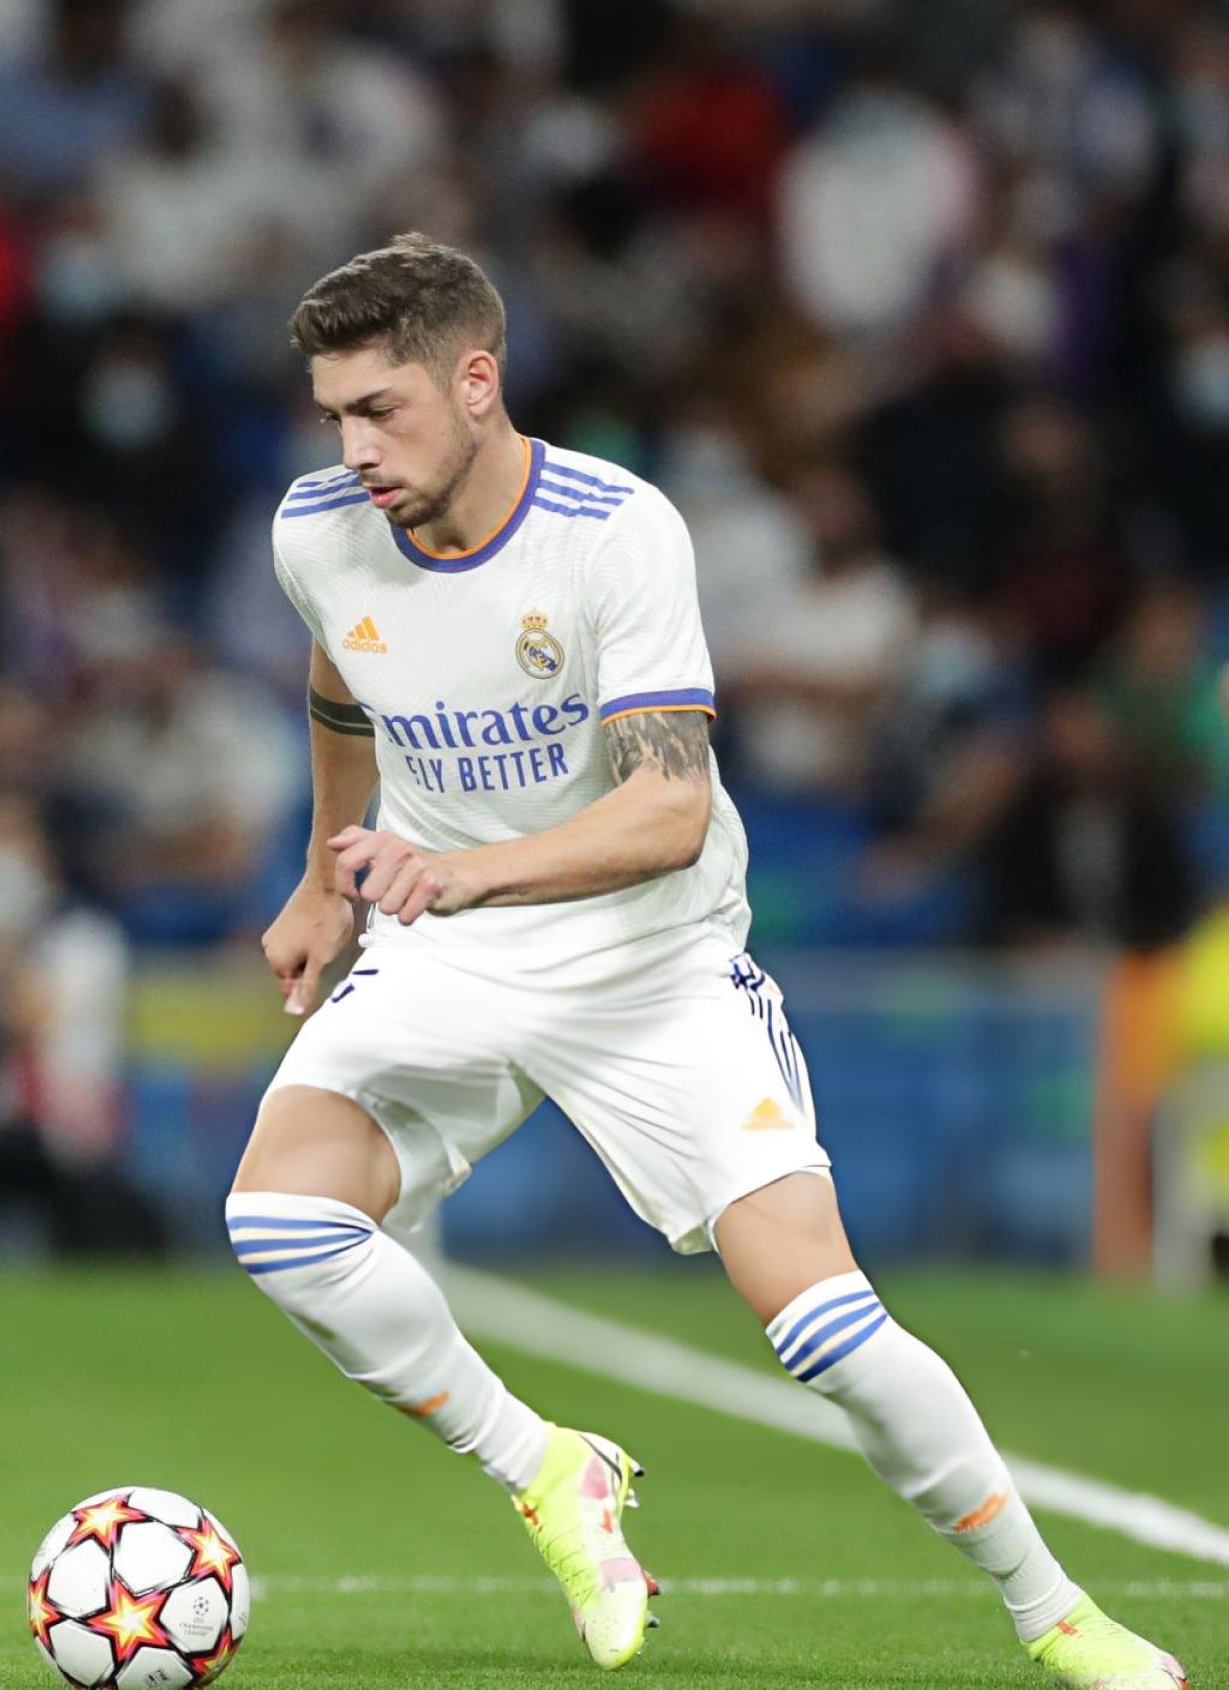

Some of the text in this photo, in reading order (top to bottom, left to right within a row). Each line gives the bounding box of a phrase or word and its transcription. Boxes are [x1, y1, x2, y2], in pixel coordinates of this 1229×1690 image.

[342, 637, 388, 654] adidas
[359, 693, 590, 751] mirates
[457, 743, 570, 793] BETTER
